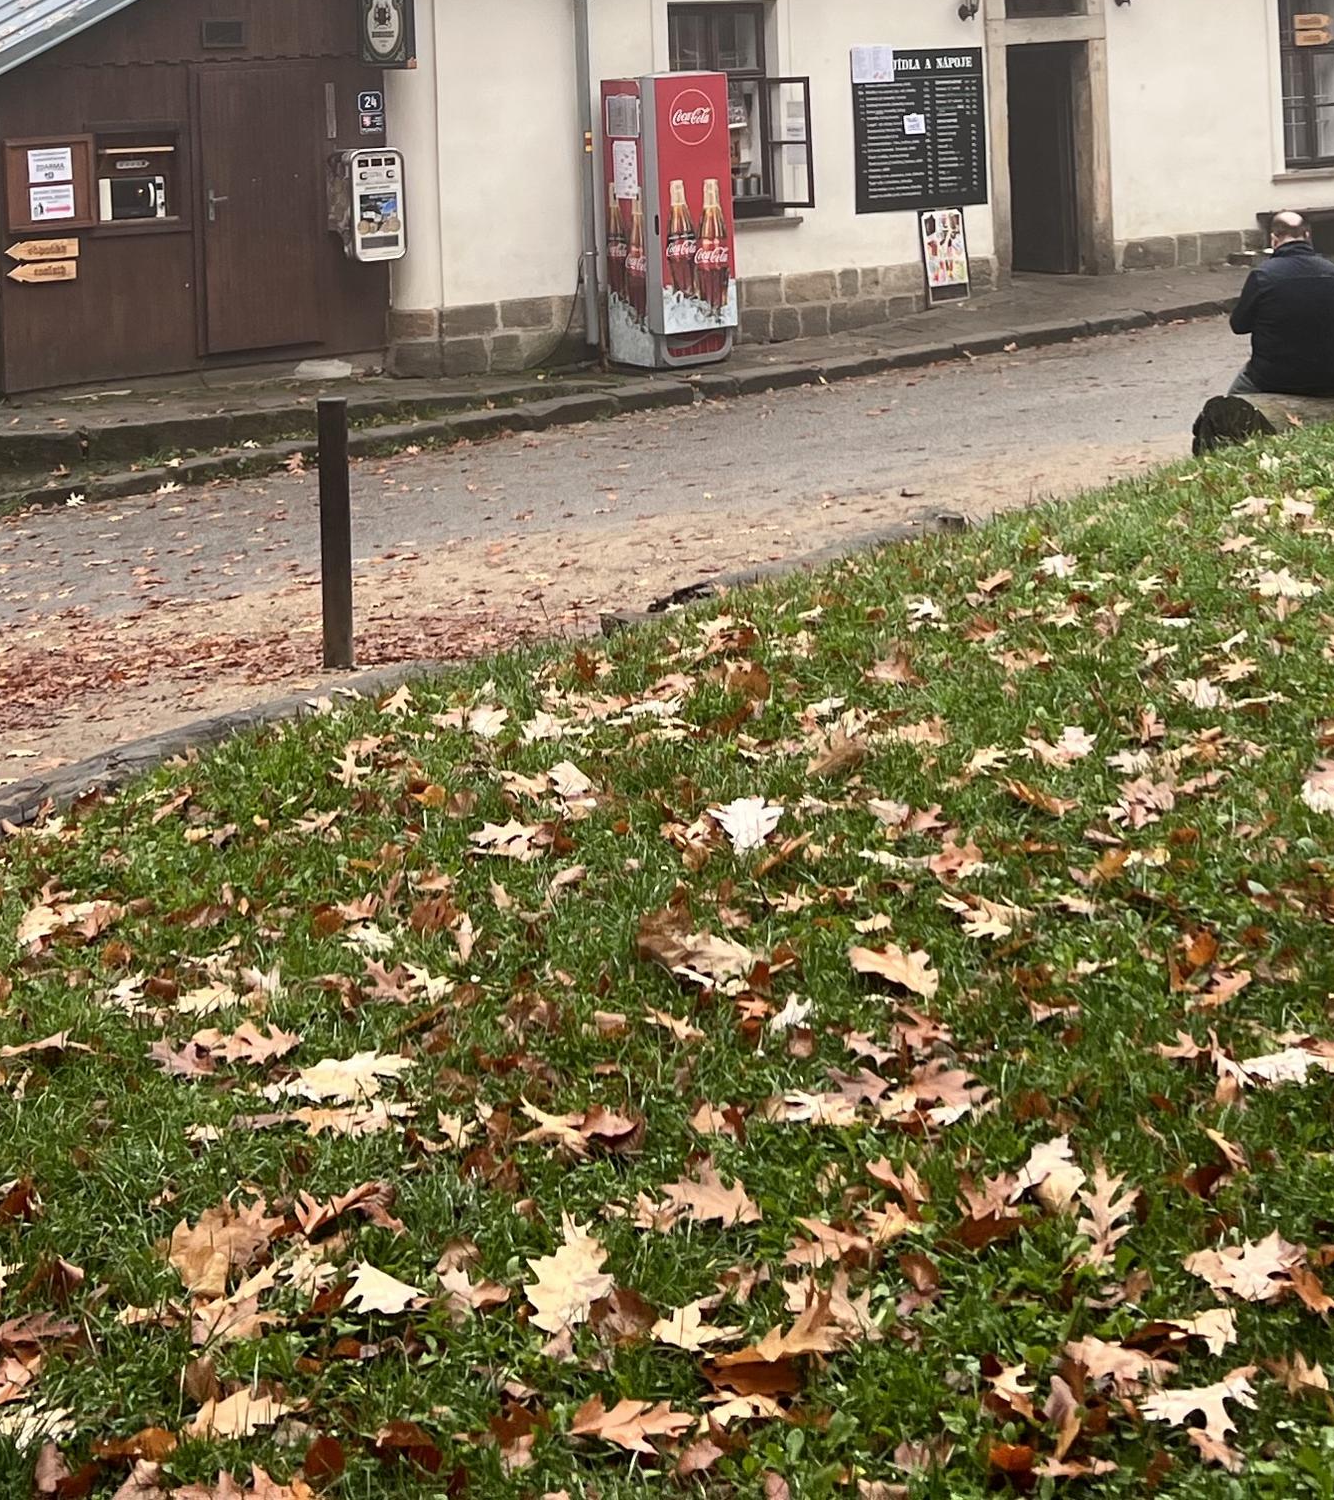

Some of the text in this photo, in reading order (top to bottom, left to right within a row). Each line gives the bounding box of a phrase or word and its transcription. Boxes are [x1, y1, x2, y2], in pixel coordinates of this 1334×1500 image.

[924, 58, 932, 70] A
[935, 56, 973, 69] NÁPOJE
[364, 96, 377, 108] 24
[672, 107, 711, 126] Coca-Cola
[694, 246, 729, 264] Coca-Cola
